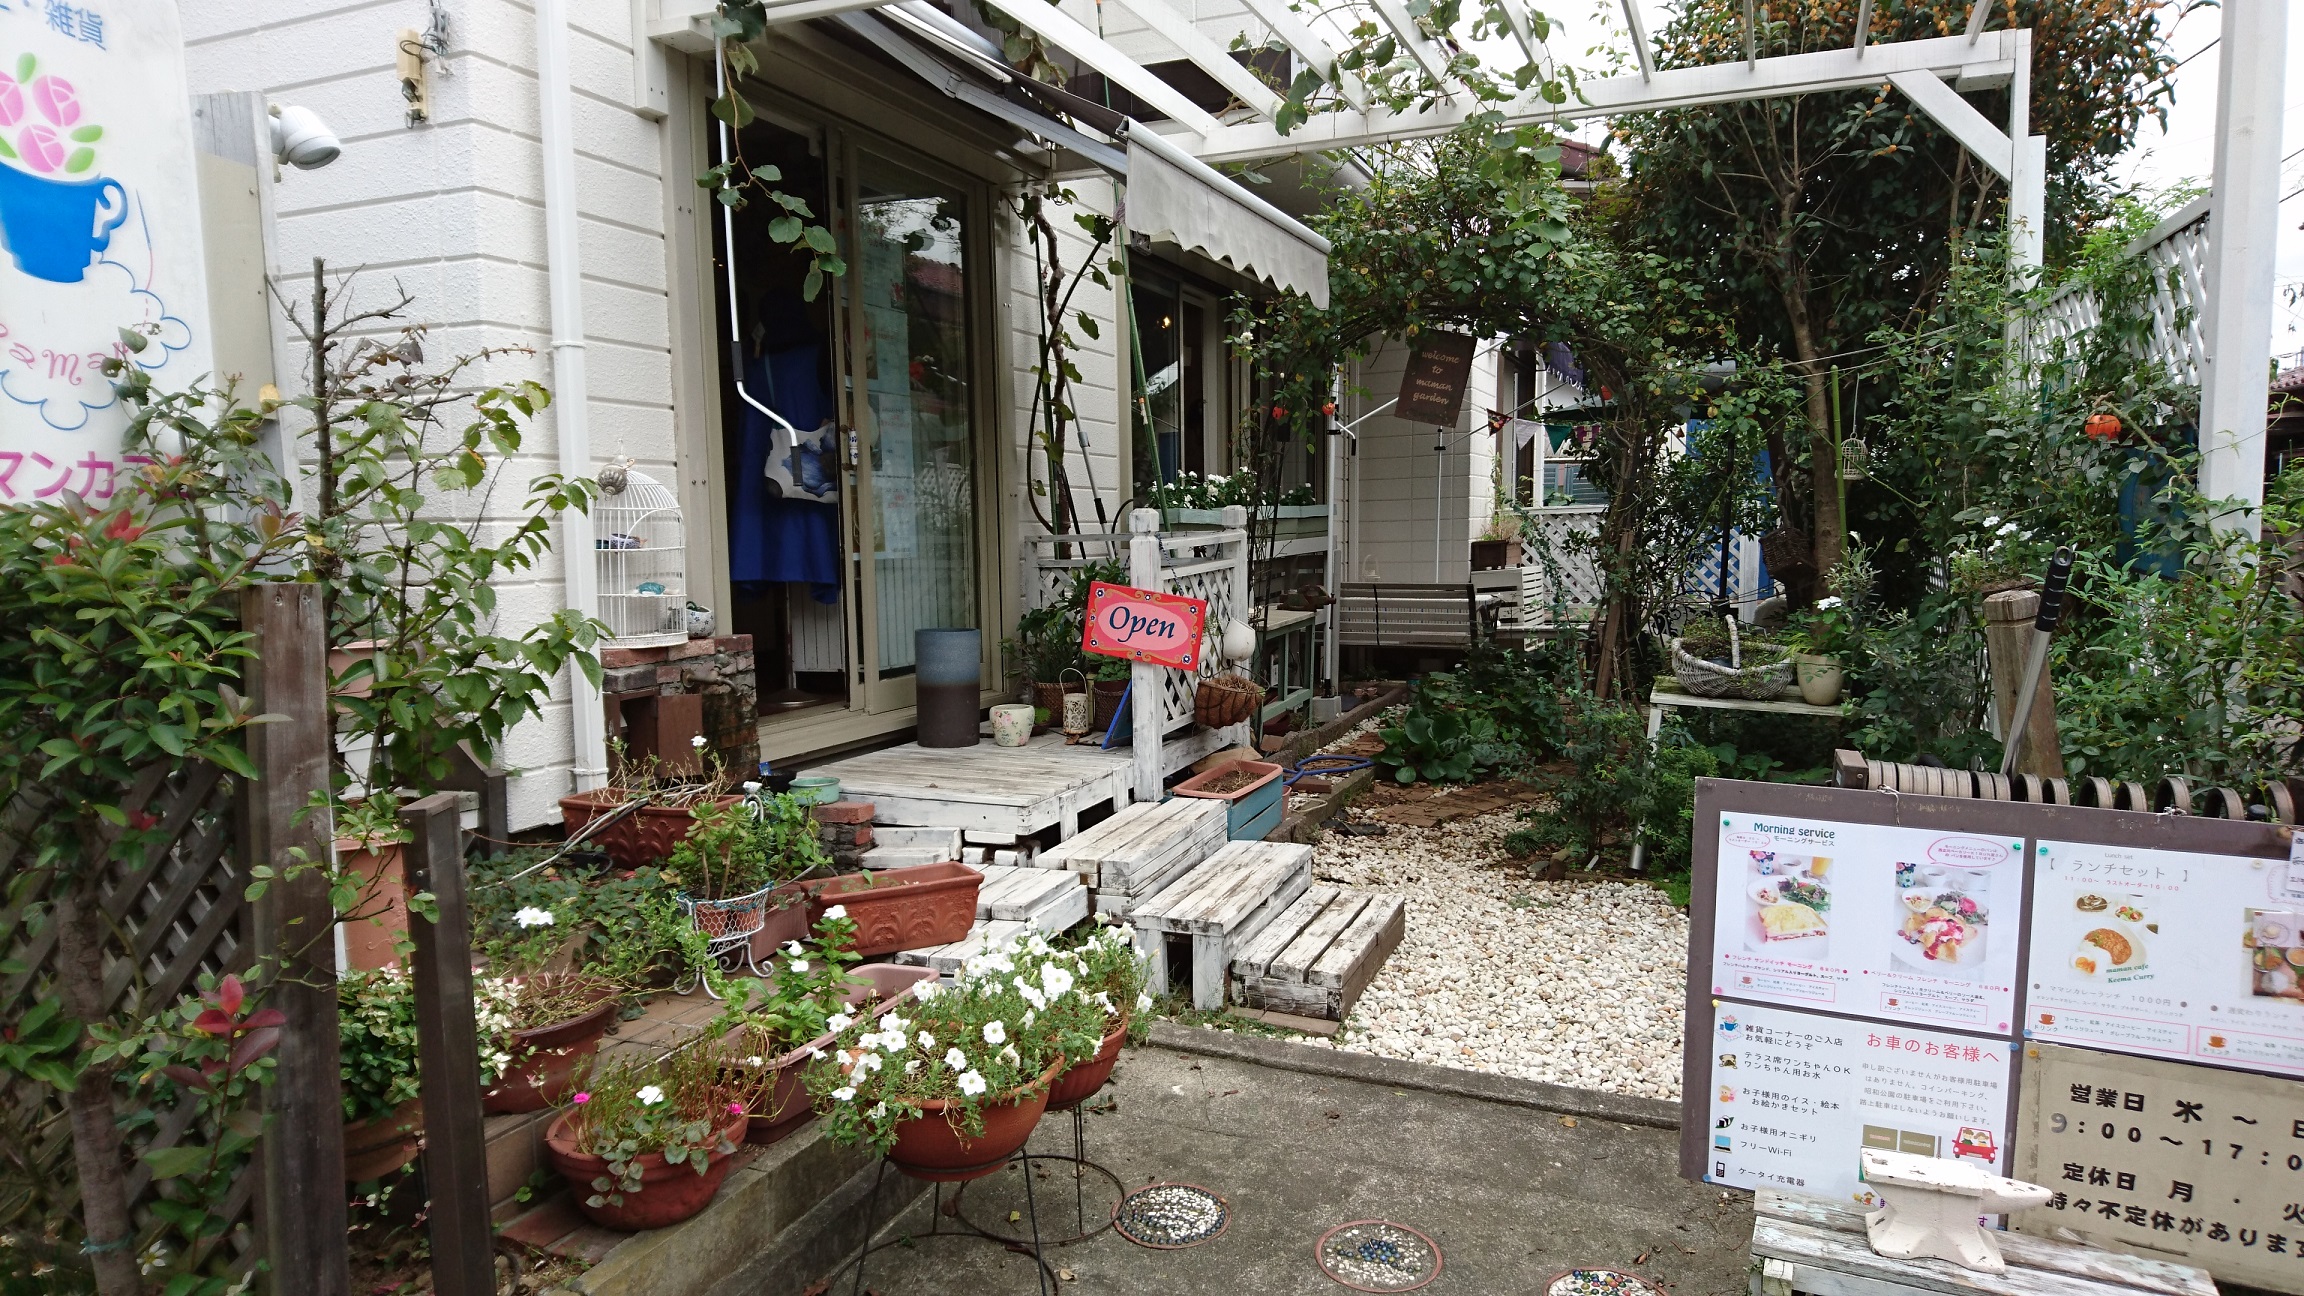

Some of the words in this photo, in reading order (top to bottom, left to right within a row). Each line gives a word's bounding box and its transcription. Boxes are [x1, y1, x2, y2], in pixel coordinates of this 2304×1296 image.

[1422, 350, 1461, 364] welcome
[1432, 365, 1443, 375] to
[1416, 378, 1453, 391] maman
[1412, 391, 1450, 405] garden
[1109, 606, 1176, 643] Open
[1753, 822, 1796, 835] Morning
[1798, 827, 1836, 839] service
[1773, 835, 1835, 847] モーニングサービス
[2072, 859, 2166, 879] ランチセット
[2105, 965, 2132, 974] maman
[2133, 963, 2149, 971] cafe
[2107, 976, 2132, 984] Keema
[2133, 973, 2155, 982] Curry
[1745, 1024, 1843, 1046] 雑貨コーナーのご入店
[1745, 1034, 1813, 1051] お気軽にどうぞ
[1867, 1033, 2000, 1062] お車のお客様へ
[1744, 1051, 1851, 1075] テラス席ワンちゃんOK
[1744, 1061, 1821, 1080] ワンちゃん用お水
[1862, 1062, 1998, 1090] 申し訳ございませんがお客様用駐車場
[1865, 1075, 1988, 1101] はありません。コインパーキング、
[2070, 1083, 2145, 1112] 営業日
[1742, 1087, 1840, 1110] お子様用のイス・絵本
[1752, 1098, 1818, 1115] お絵かきセット
[1864, 1087, 1988, 1113] 昭和公園の駐車場をご利用下さい。
[1859, 1098, 1991, 1126] 路上駐車はしないようお願いします。
[1740, 1123, 1817, 1143] お子様用オニギリ
[1740, 1141, 1792, 1157] フリーWi-Fi
[1738, 1167, 1806, 1187] ケータイ充電器
[2061, 1162, 2137, 1192] 定休日
[2167, 1180, 2195, 1203] 月
